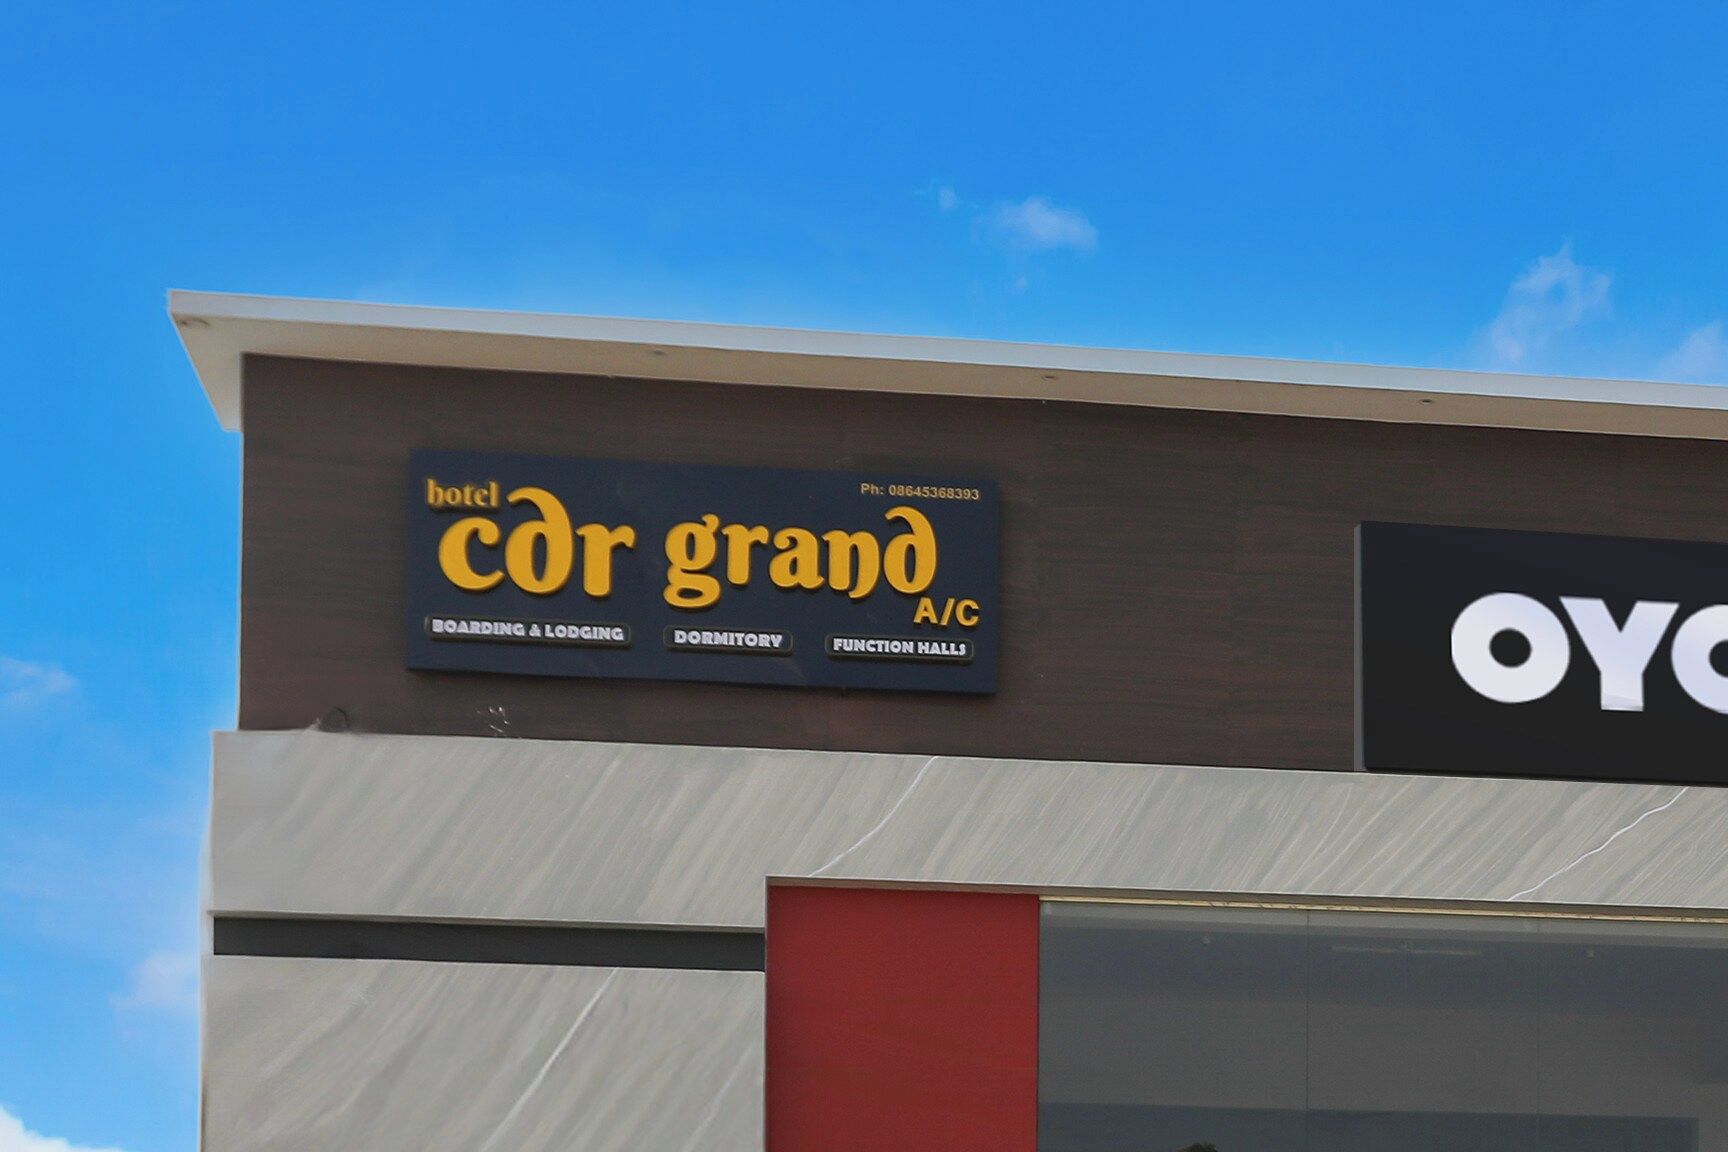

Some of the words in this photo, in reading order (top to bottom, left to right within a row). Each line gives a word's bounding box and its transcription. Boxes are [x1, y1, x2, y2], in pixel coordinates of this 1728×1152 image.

[426, 478, 499, 508] hotel
[860, 483, 884, 496] Ph:
[888, 485, 980, 500] 08645368393
[438, 486, 637, 597] cdr
[663, 506, 937, 608] grand
[913, 597, 980, 627] A/C
[431, 618, 525, 637] BOARDING
[529, 624, 541, 638] &
[544, 624, 625, 642] LODGING
[673, 629, 783, 649] DORMITORY
[833, 637, 914, 655] FUNCTION
[917, 641, 967, 656] HALLS
